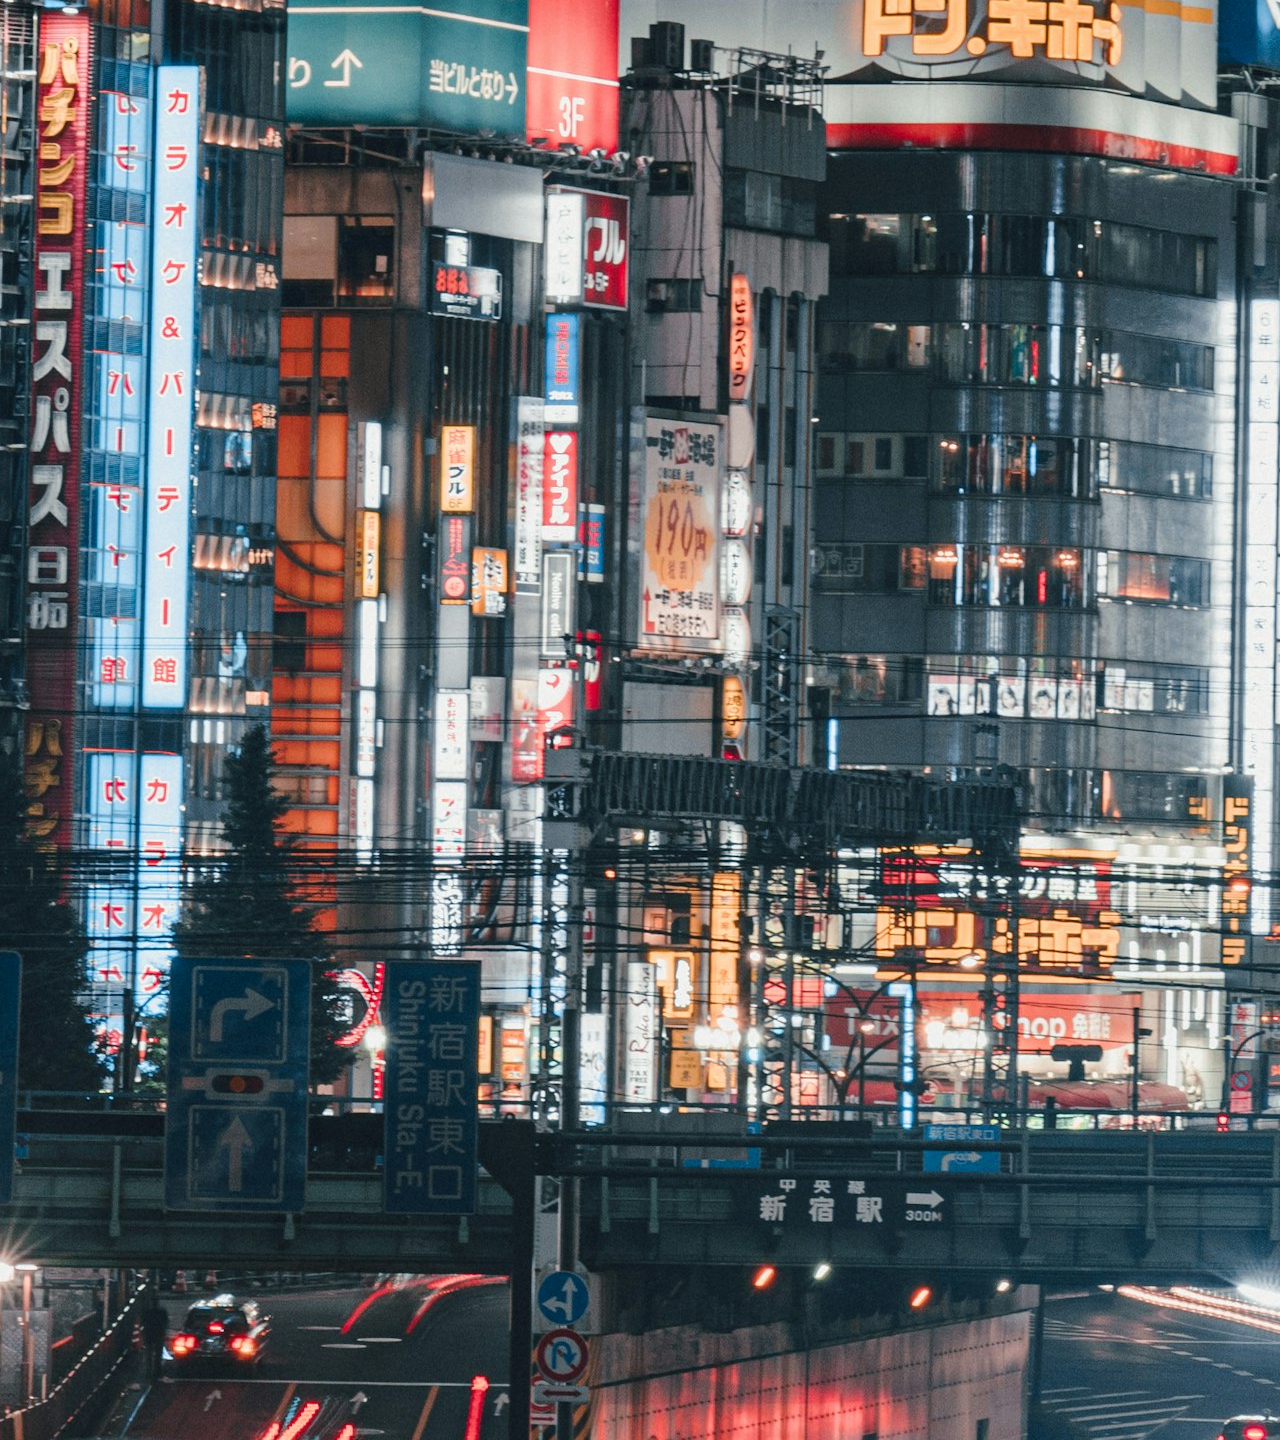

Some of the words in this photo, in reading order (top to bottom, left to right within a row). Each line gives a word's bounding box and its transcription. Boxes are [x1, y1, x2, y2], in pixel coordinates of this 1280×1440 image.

[428, 58, 505, 101] 当ビルとなり
[558, 96, 586, 140] 3F
[38, 36, 80, 236] パチンコ
[29, 252, 74, 528] エスパス
[153, 88, 190, 684] カラオケ&パーティー館
[554, 321, 570, 386] PROMISE
[549, 453, 571, 525] アイフル
[26, 545, 70, 631] 日拓
[396, 980, 427, 1093] Shinjuku
[425, 975, 469, 1201] 新宿駅東口
[927, 1126, 995, 1142] 新宿駅東口
[758, 1193, 884, 1225] 新宿駅
[905, 1210, 943, 1223] 300M
